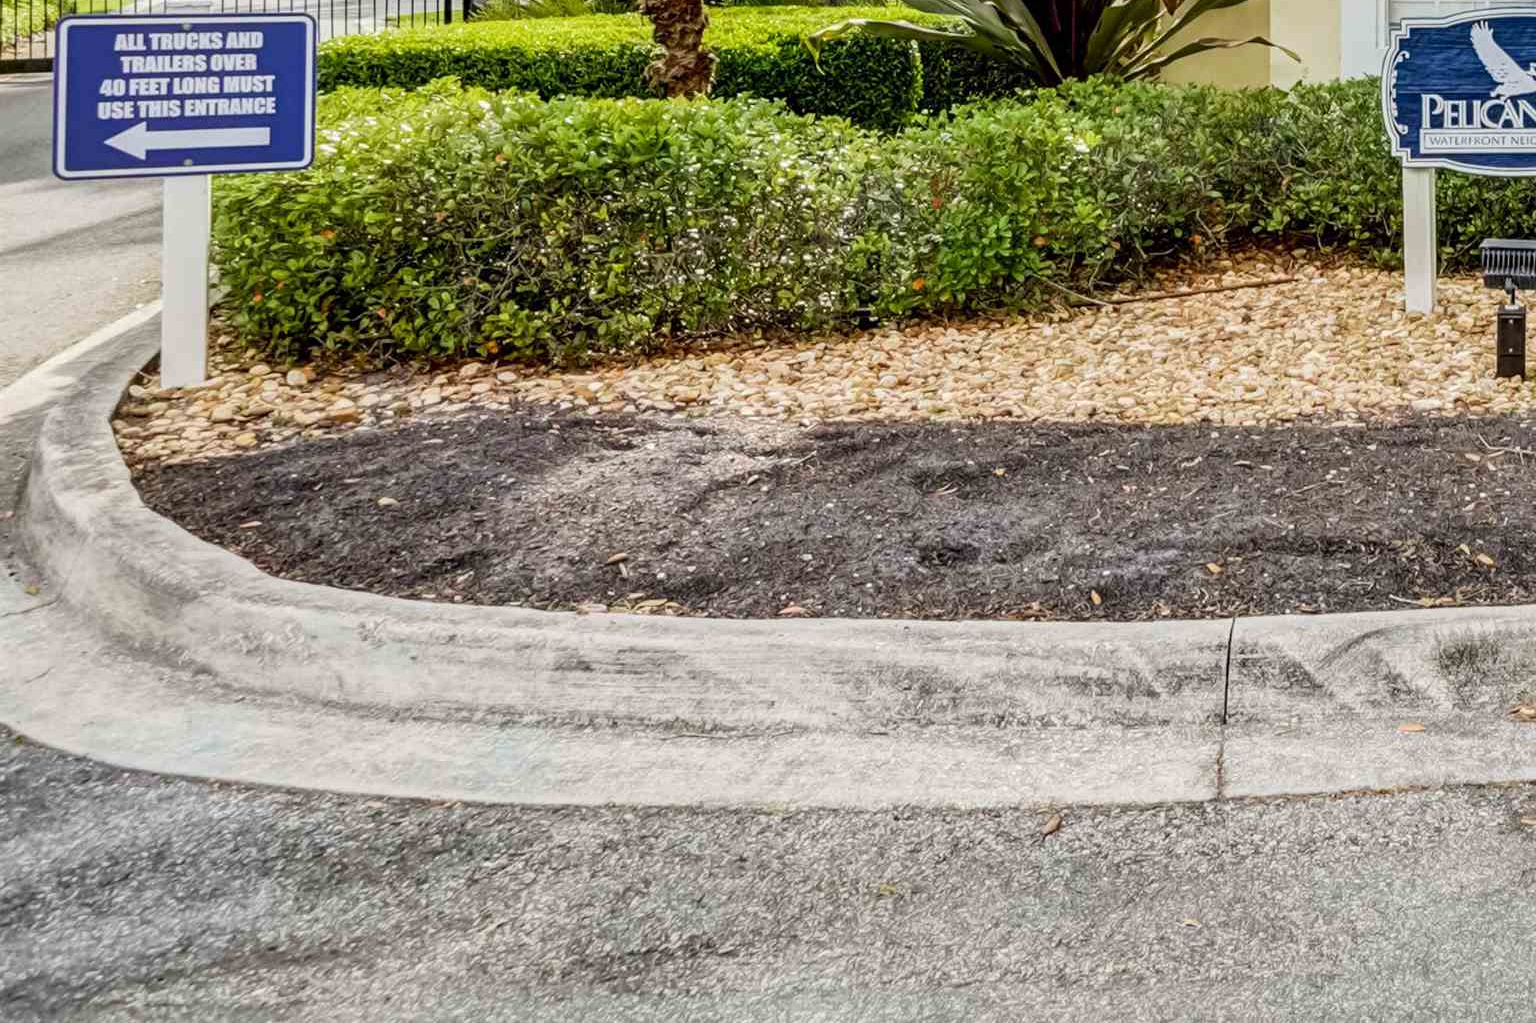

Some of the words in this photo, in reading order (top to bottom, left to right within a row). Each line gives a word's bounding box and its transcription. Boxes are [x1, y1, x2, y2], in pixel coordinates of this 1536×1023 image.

[114, 33, 147, 51] ALL
[149, 32, 223, 50] TRUCKS
[226, 31, 264, 49] AND
[120, 54, 207, 74] TRAILERS
[210, 53, 257, 71] OVER
[99, 79, 126, 97] 40
[129, 78, 171, 96] FEET
[173, 77, 220, 95] LONG
[223, 75, 276, 93] MUST
[97, 101, 134, 119] USE
[137, 99, 181, 118] THIS
[184, 97, 276, 117] ENTRANCE
[1429, 135, 1507, 146] WATERFRONT
